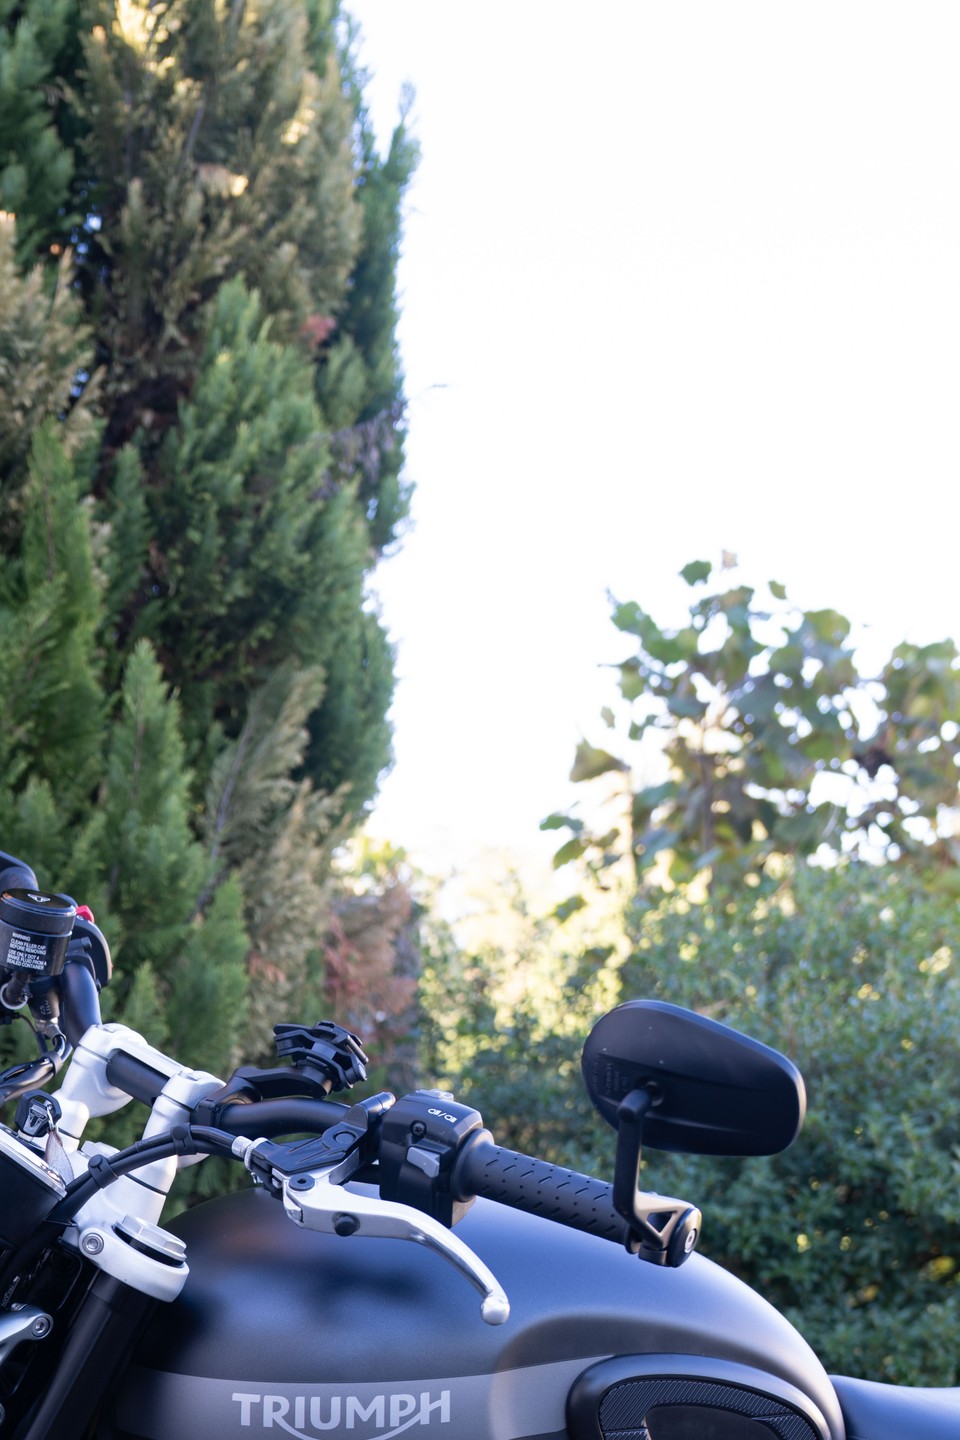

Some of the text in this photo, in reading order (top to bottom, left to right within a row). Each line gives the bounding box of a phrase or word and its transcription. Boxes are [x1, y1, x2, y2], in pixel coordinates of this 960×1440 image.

[12, 932, 31, 941] WARNING
[10, 938, 24, 946] CLEAN
[9, 942, 47, 955] BEFORE REMOVING
[21, 962, 45, 970] CONTAINER
